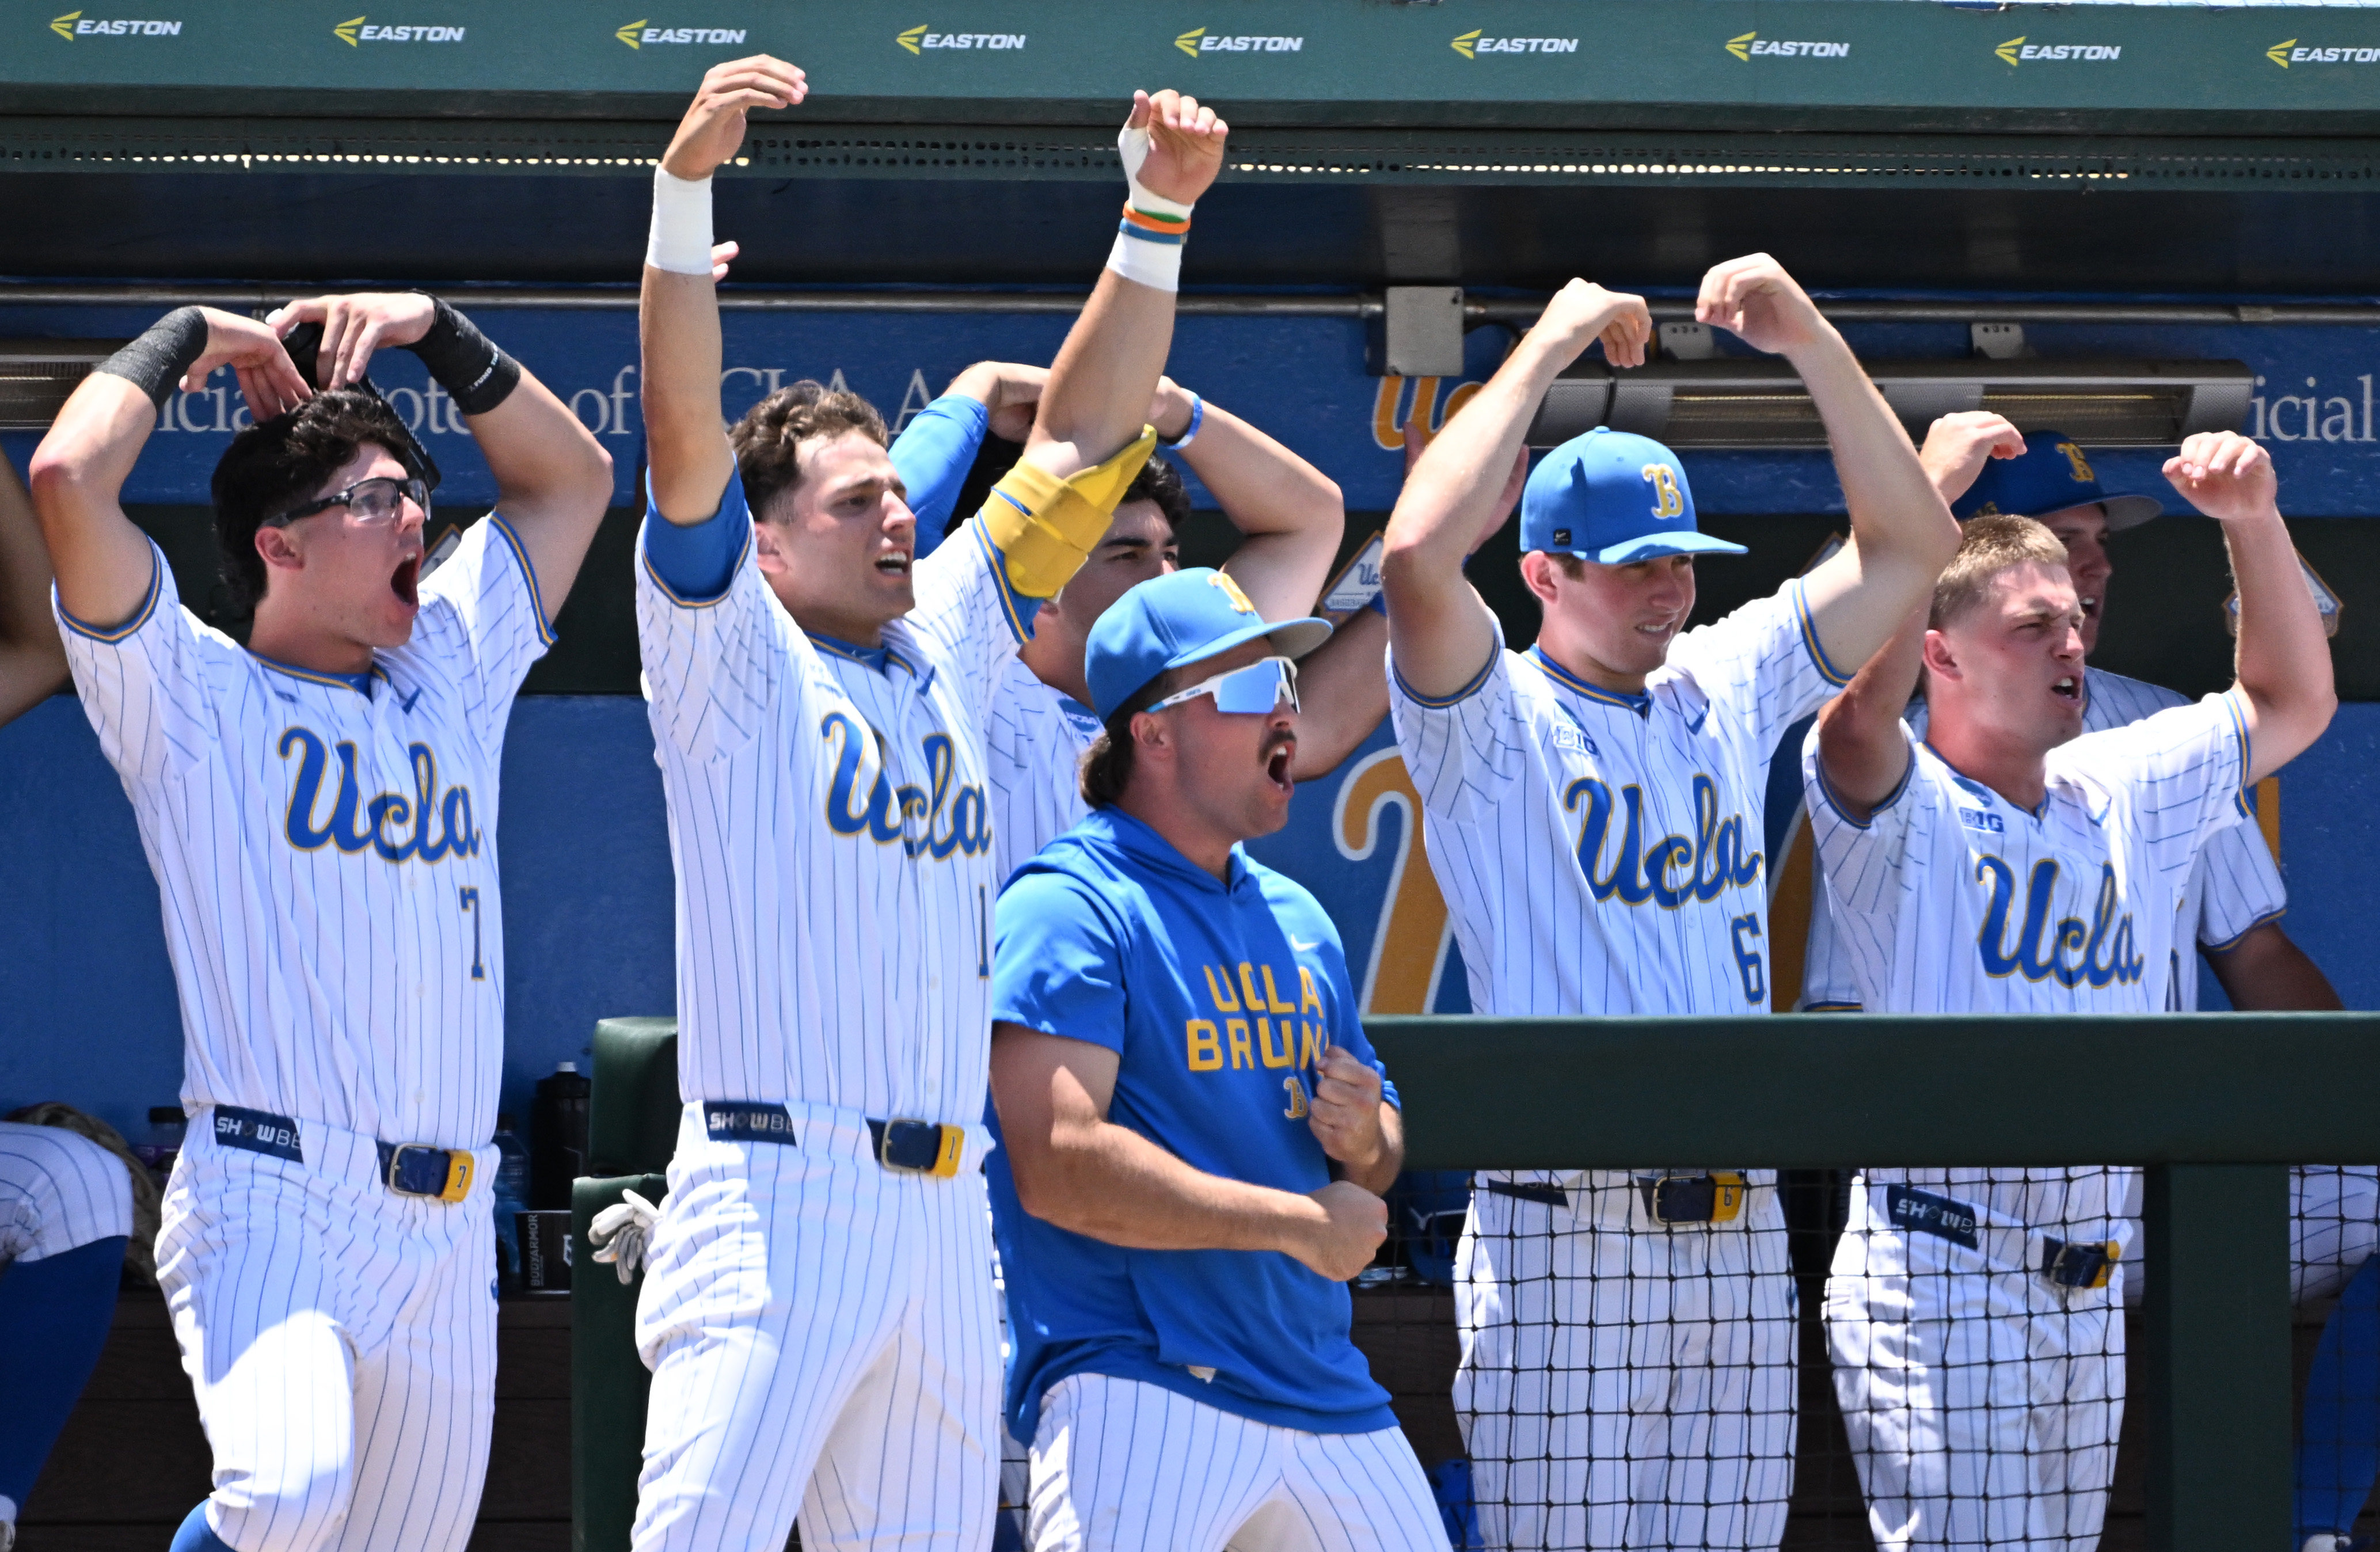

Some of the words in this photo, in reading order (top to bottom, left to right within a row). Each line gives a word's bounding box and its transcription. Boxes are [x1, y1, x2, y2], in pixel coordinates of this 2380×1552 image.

[76, 20, 182, 35] EASTON
[359, 25, 465, 41] EASTON
[641, 28, 747, 44] EASTON
[921, 33, 1026, 50] EASTON
[1199, 36, 1304, 51] EASTON
[1476, 38, 1579, 52] EASTON
[1750, 40, 1850, 57] EASTON
[2019, 45, 2122, 60] EASTON
[568, 366, 636, 435] of
[2250, 373, 2377, 443] icial
[2055, 442, 2094, 482] B
[1641, 463, 1683, 519] B
[276, 725, 481, 865] Ucla
[821, 710, 992, 862] Ucla
[1563, 773, 1764, 911] Ucla
[460, 885, 485, 982] 7
[1975, 853, 2145, 990] Ucla
[1731, 912, 1767, 1006] 6
[1203, 961, 1324, 1019] UCLA
[1186, 1017, 1330, 1073] BRUIN
[1283, 1076, 1308, 1119] B
[457, 1165, 467, 1188] 7
